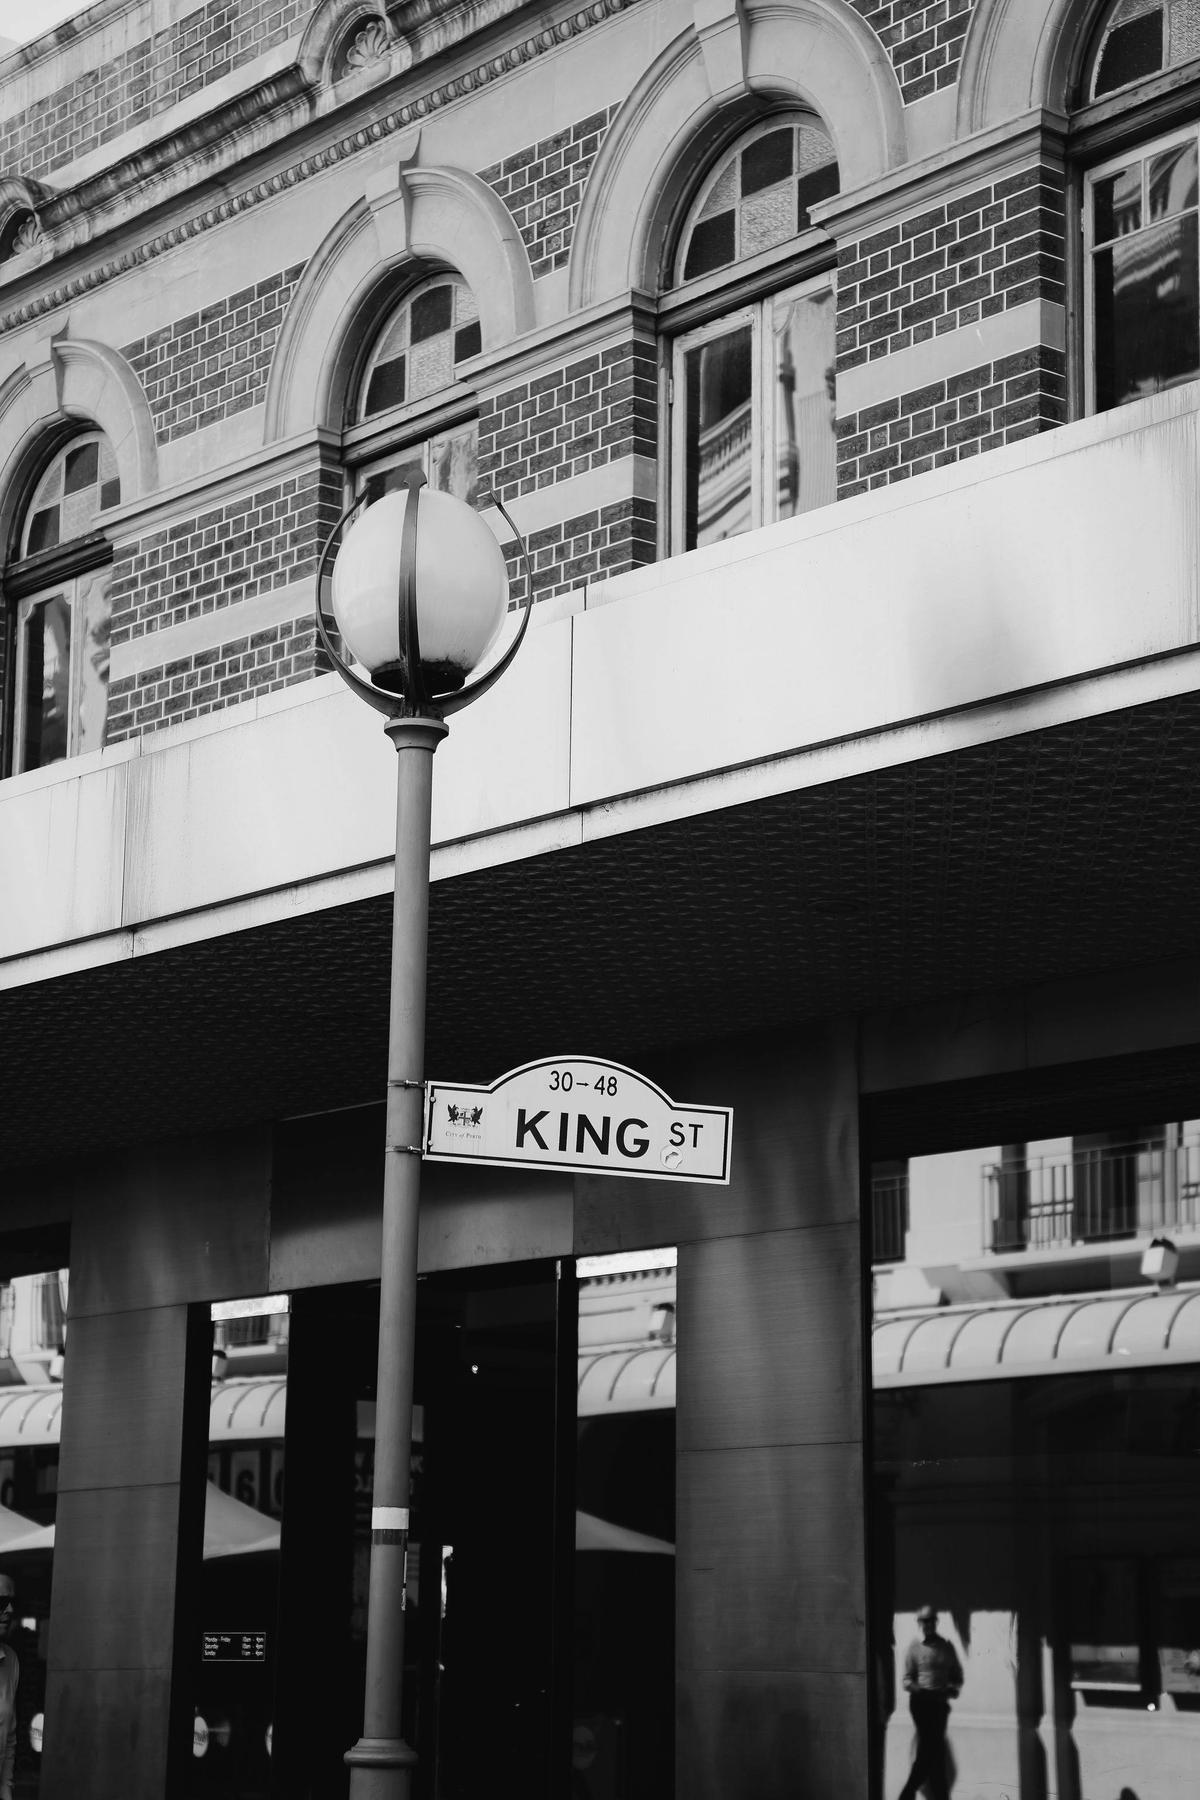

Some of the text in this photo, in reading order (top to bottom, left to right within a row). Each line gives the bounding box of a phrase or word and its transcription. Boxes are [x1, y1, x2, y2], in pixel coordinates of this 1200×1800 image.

[548, 1070, 618, 1097] 30 48
[515, 1108, 704, 1159] KING ST
